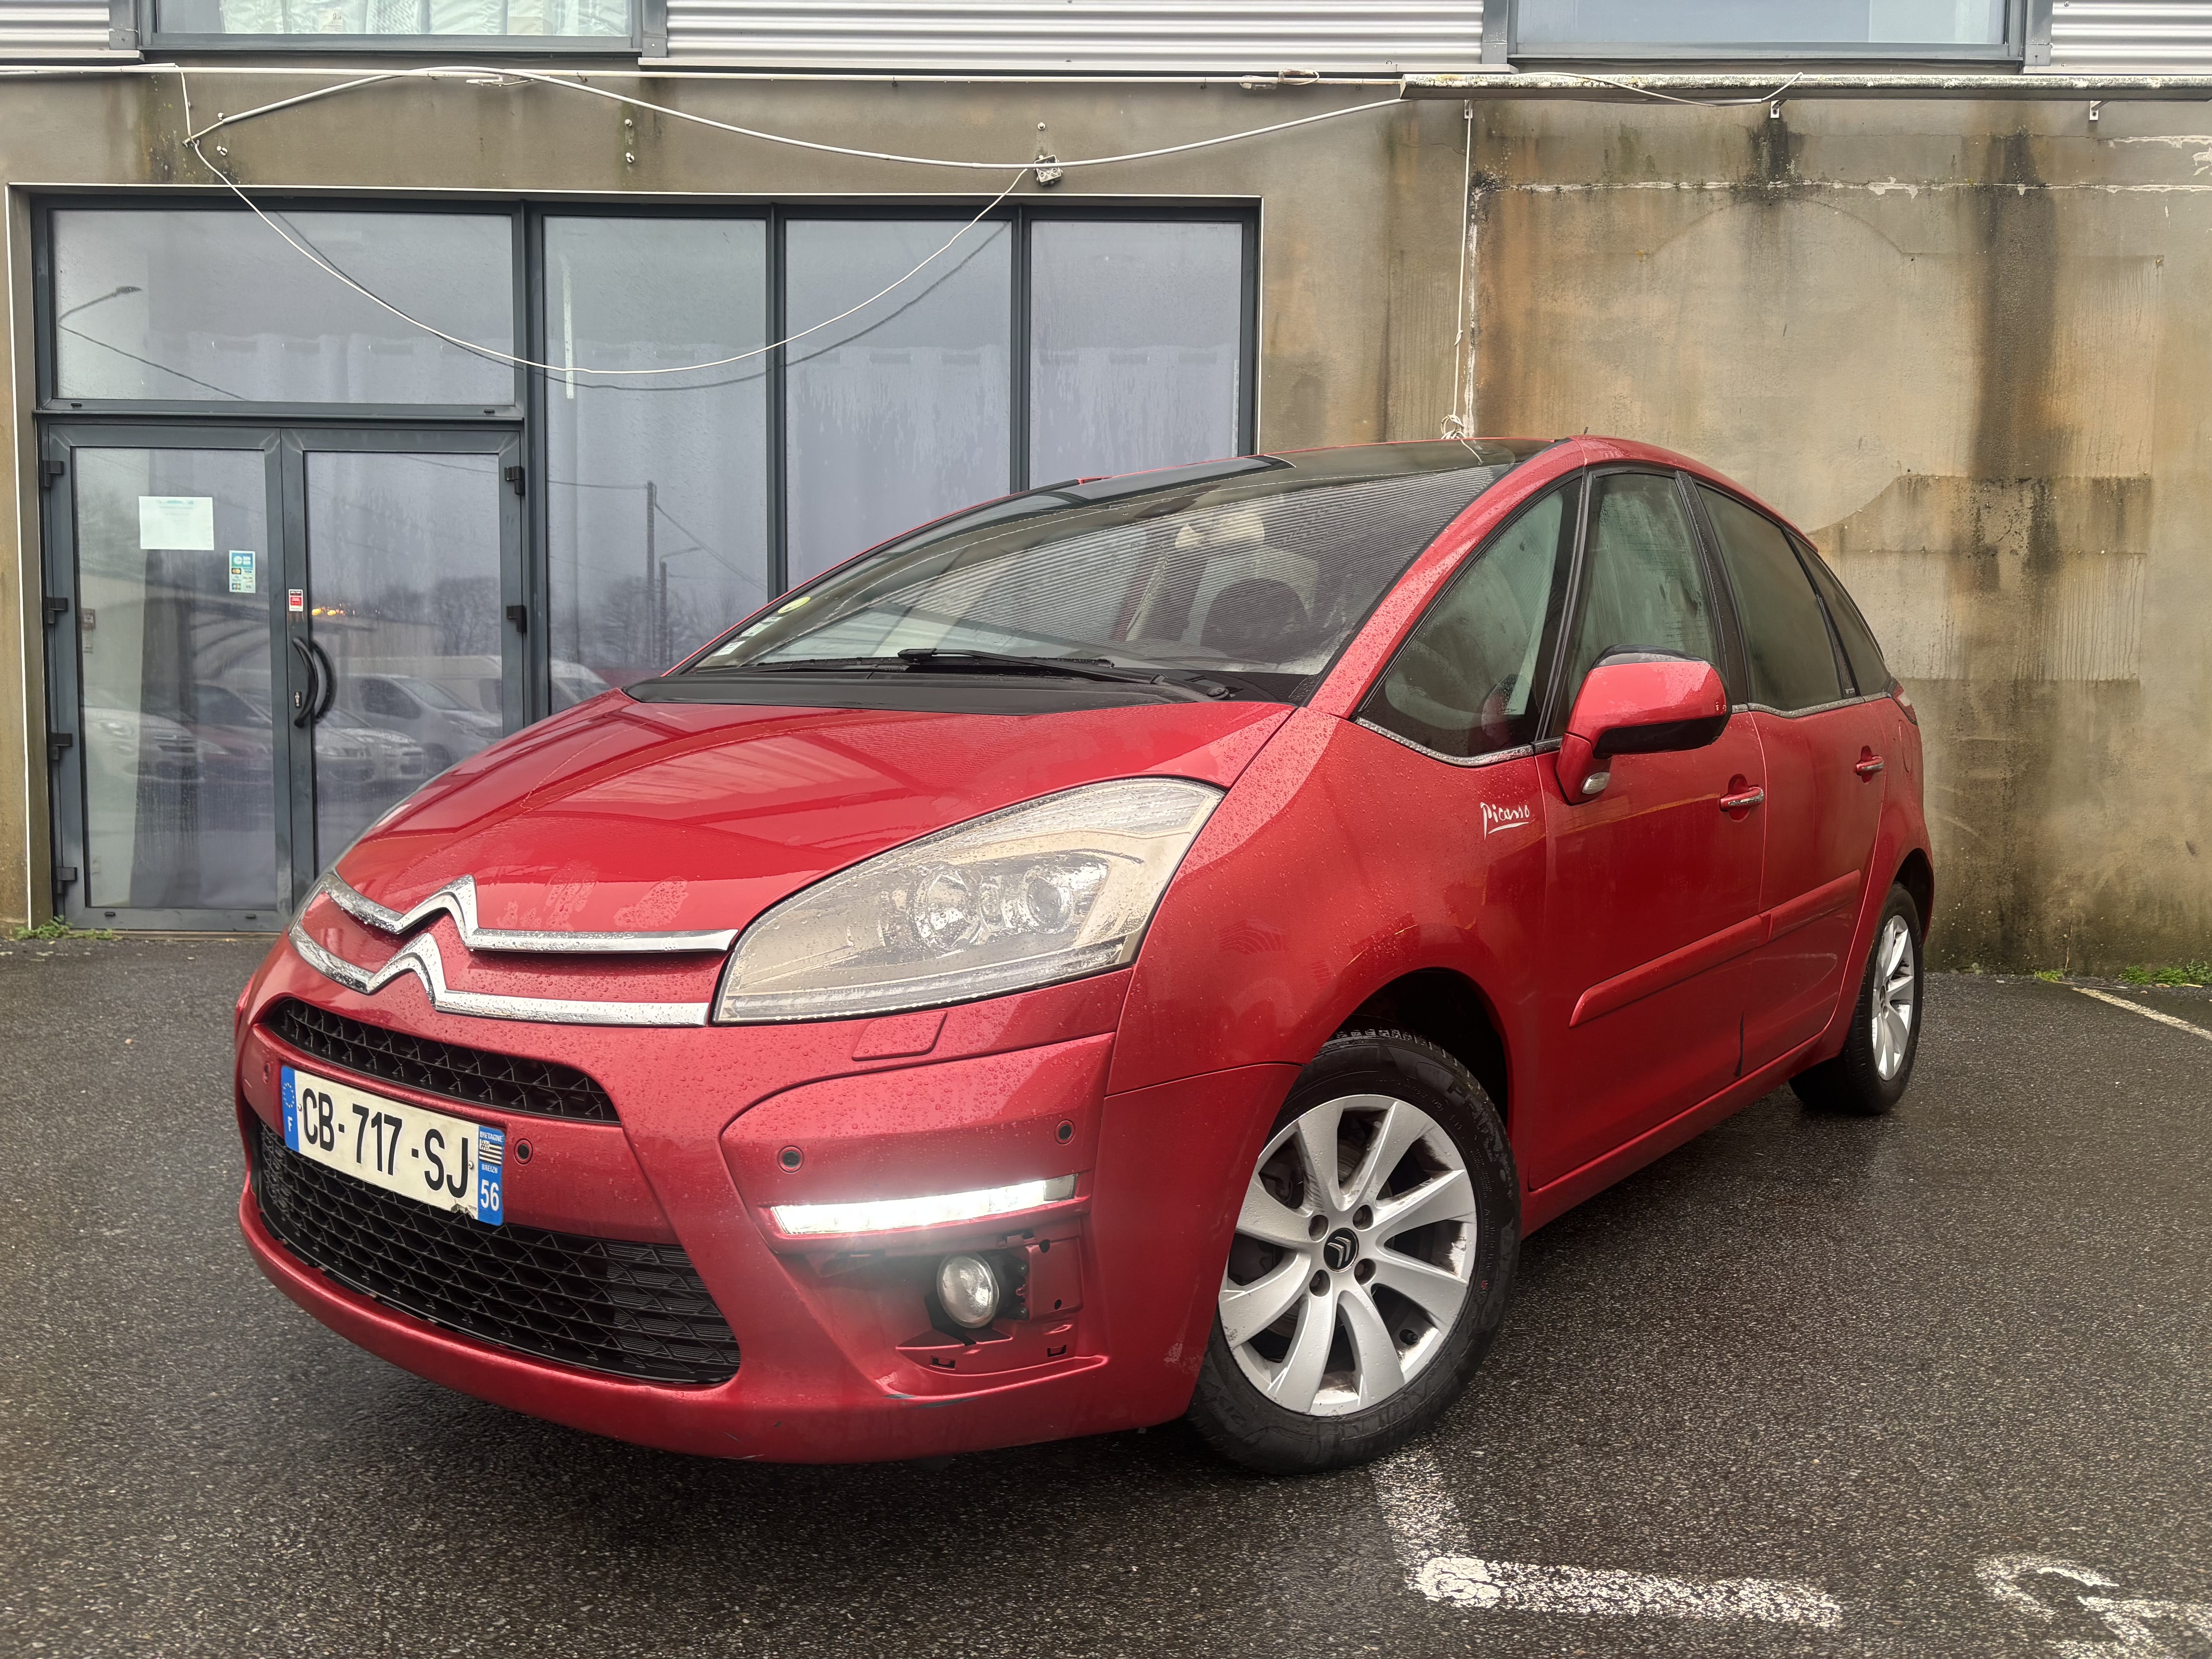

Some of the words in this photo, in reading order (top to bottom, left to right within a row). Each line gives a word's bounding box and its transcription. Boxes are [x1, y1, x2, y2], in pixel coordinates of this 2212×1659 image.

[1480, 801, 1530, 841] Picasso
[287, 1116, 292, 1132] F
[479, 1131, 503, 1143] BRETAGNE
[481, 1163, 498, 1174] BREIZH
[480, 1179, 500, 1211] 56
